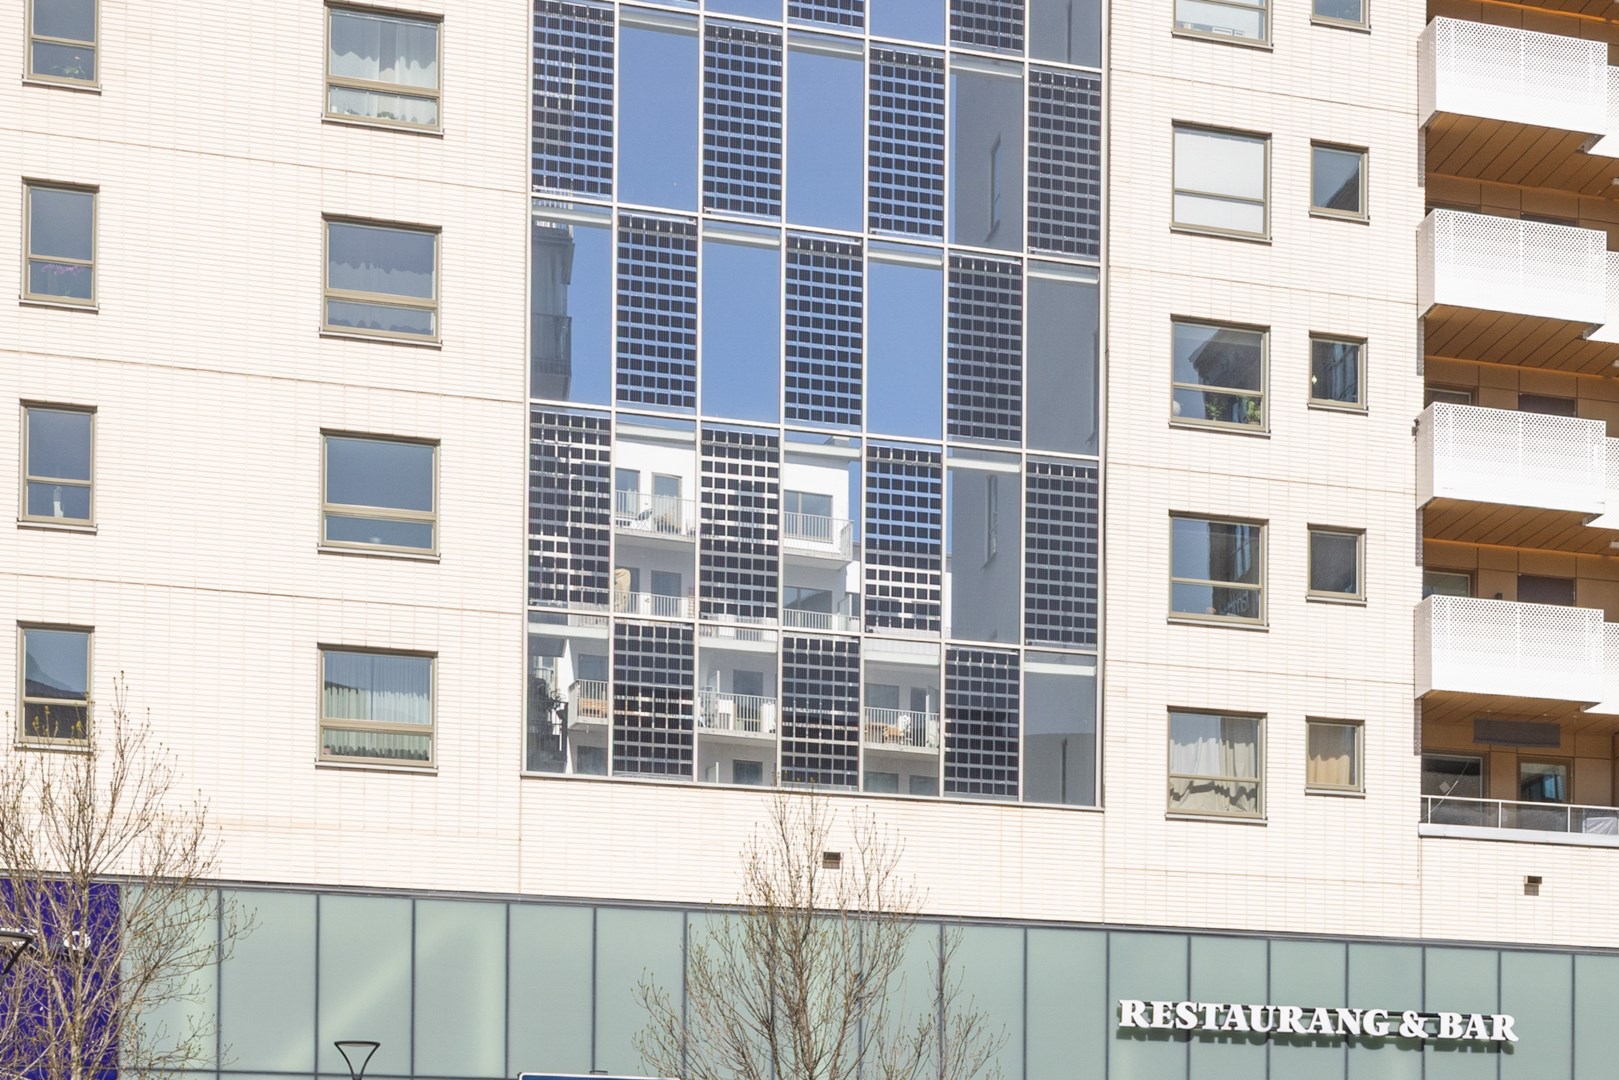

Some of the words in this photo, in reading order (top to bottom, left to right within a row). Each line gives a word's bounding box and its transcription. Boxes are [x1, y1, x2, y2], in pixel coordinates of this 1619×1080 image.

[1119, 999, 1391, 1037] RESTAURANG
[1399, 1010, 1429, 1039] &
[1437, 1012, 1519, 1042] BAR
